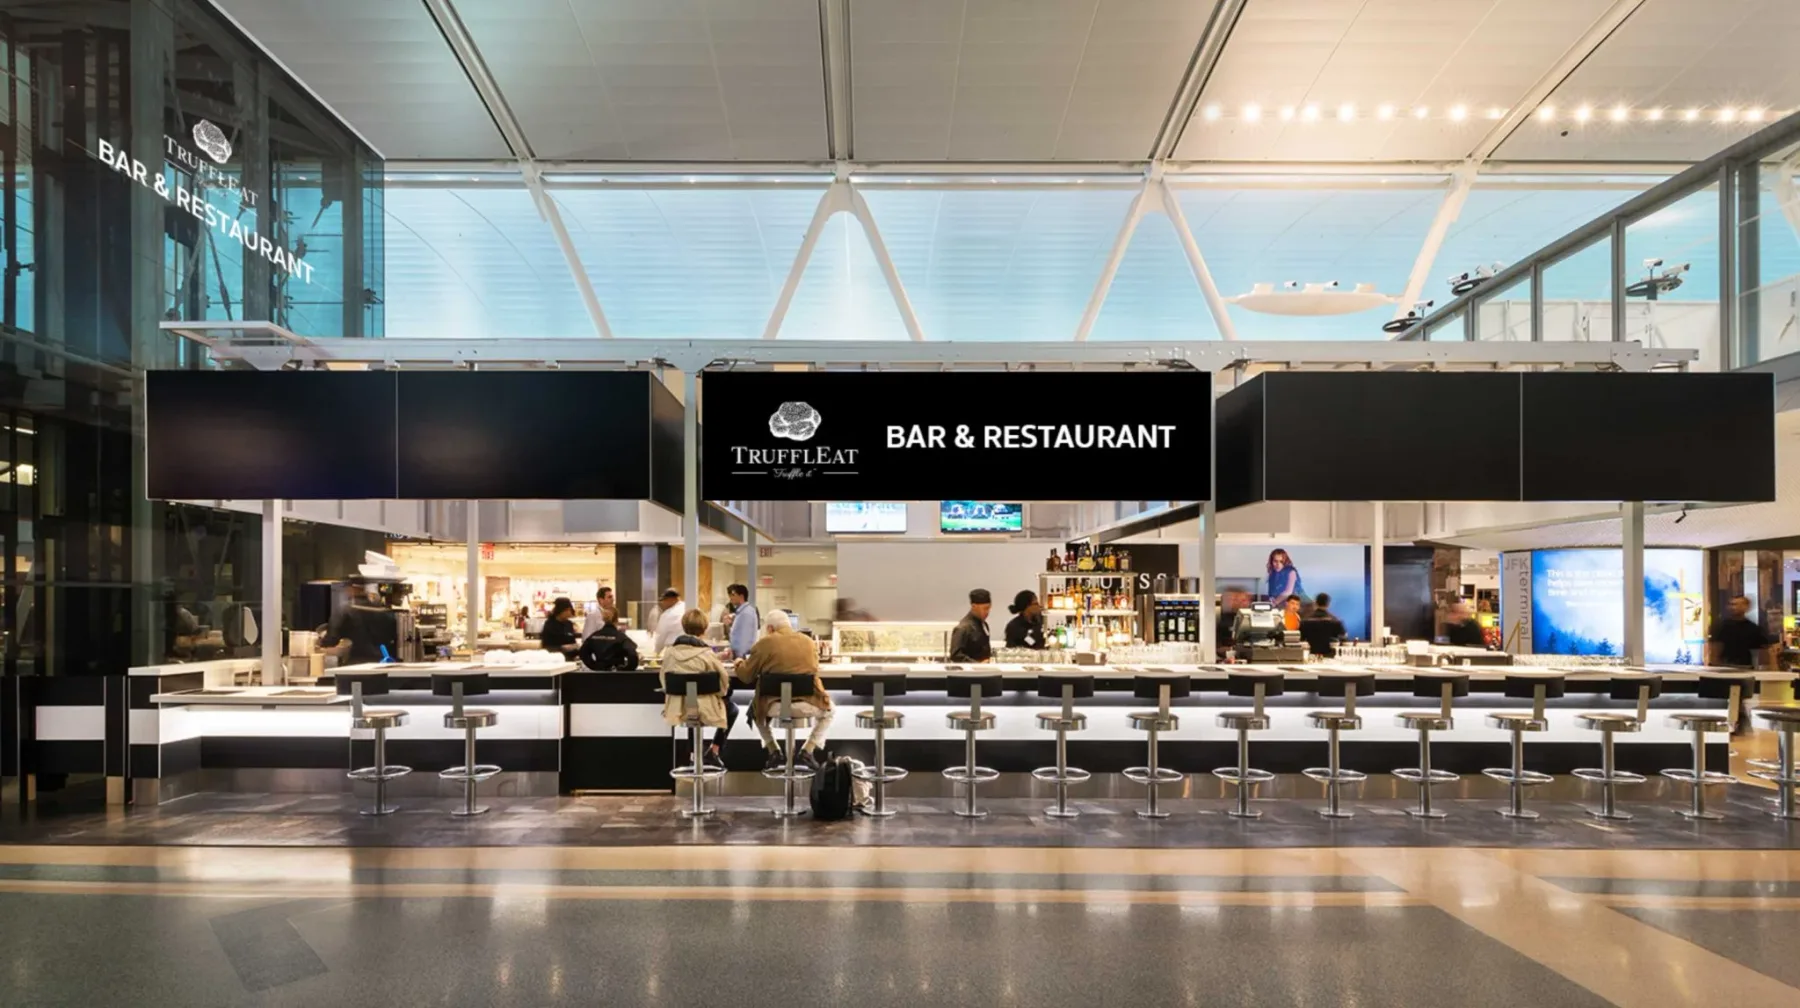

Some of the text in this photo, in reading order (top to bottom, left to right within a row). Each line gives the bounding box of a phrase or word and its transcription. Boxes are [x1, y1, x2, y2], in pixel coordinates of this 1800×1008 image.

[99, 138, 148, 187] BAR
[154, 172, 170, 200] &
[176, 186, 314, 285] RESTAURANT
[887, 424, 1176, 448] BAR & RESTAURANT
[1504, 557, 1529, 570] JFK
[1519, 570, 1530, 640] terminal
